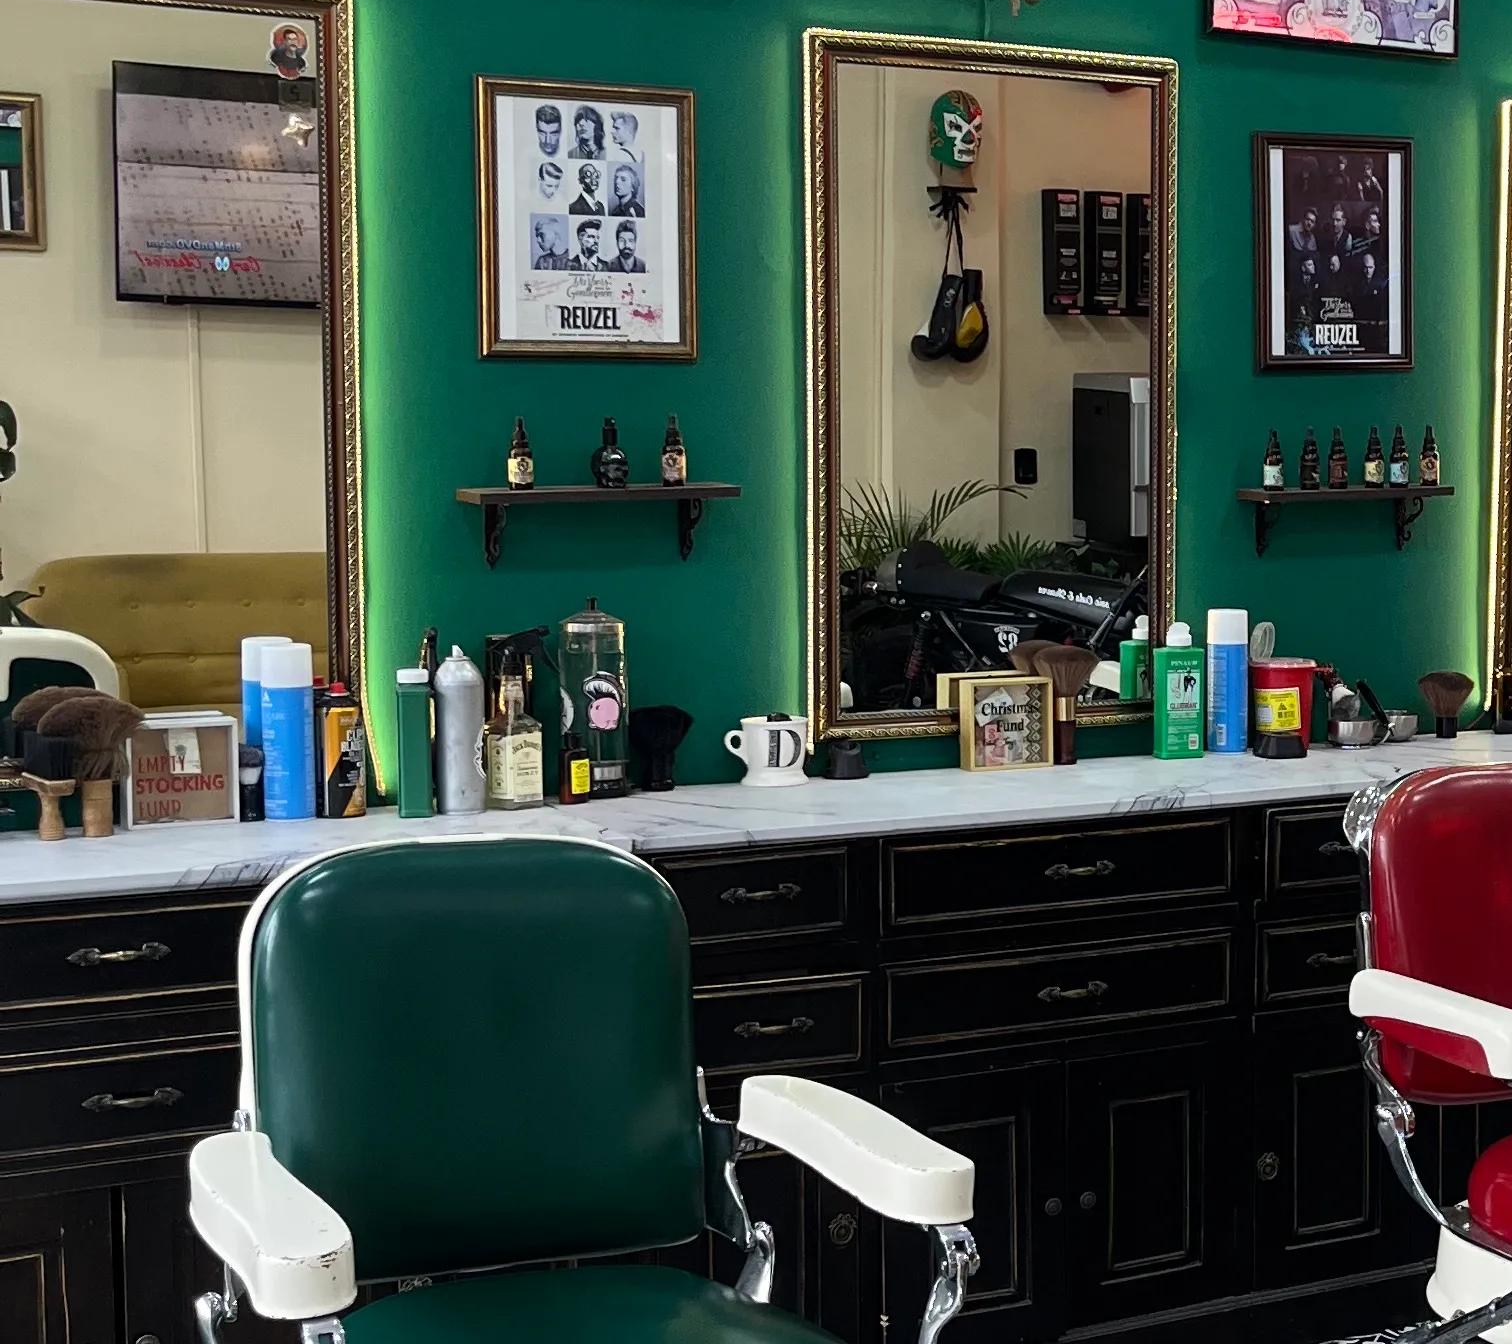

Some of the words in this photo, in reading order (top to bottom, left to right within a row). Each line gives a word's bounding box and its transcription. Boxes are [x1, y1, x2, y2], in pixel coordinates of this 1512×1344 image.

[560, 305, 621, 330] REUZEL
[1315, 324, 1359, 346] REUZEL
[996, 718, 1024, 733] Fund
[764, 728, 802, 768] D
[138, 754, 187, 774] EMPTY
[136, 774, 225, 795] STOCKING
[138, 799, 182, 818] FUND
